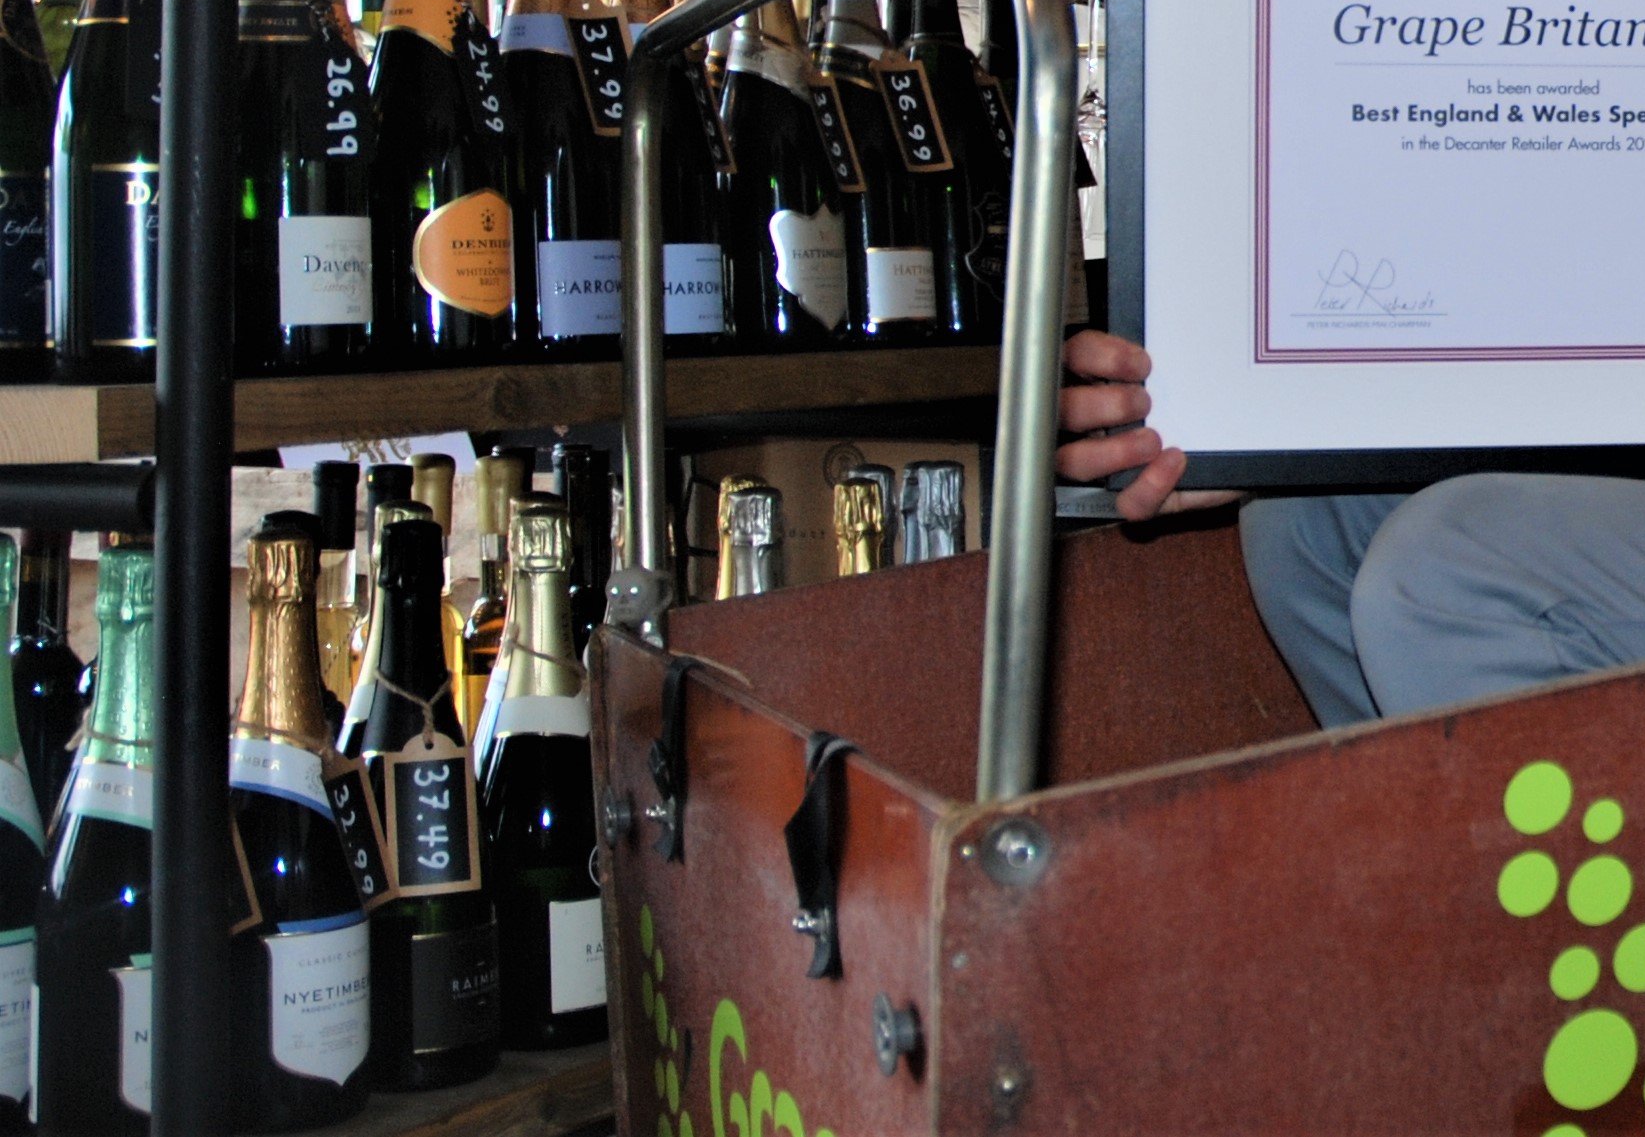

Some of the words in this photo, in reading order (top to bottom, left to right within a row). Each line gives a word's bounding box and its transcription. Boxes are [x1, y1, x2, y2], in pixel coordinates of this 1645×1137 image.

[1333, 3, 1485, 57] Grape
[325, 57, 360, 157] 26.99
[467, 38, 505, 133] 24.99
[890, 74, 933, 163] 36.99
[1351, 104, 1399, 123] Best
[1407, 103, 1499, 127] England
[1507, 105, 1523, 123] &
[1532, 105, 1601, 125] Wales
[1467, 79, 1492, 95] has
[1497, 79, 1532, 95] been
[1536, 79, 1600, 95] awarded
[1401, 136, 1414, 151] in
[1419, 136, 1440, 151] the
[1444, 136, 1507, 152] Decanter
[1511, 136, 1563, 152] Retailer
[1567, 137, 1622, 152] Awards
[333, 783, 376, 896] 32.99
[413, 763, 451, 870] 37.49
